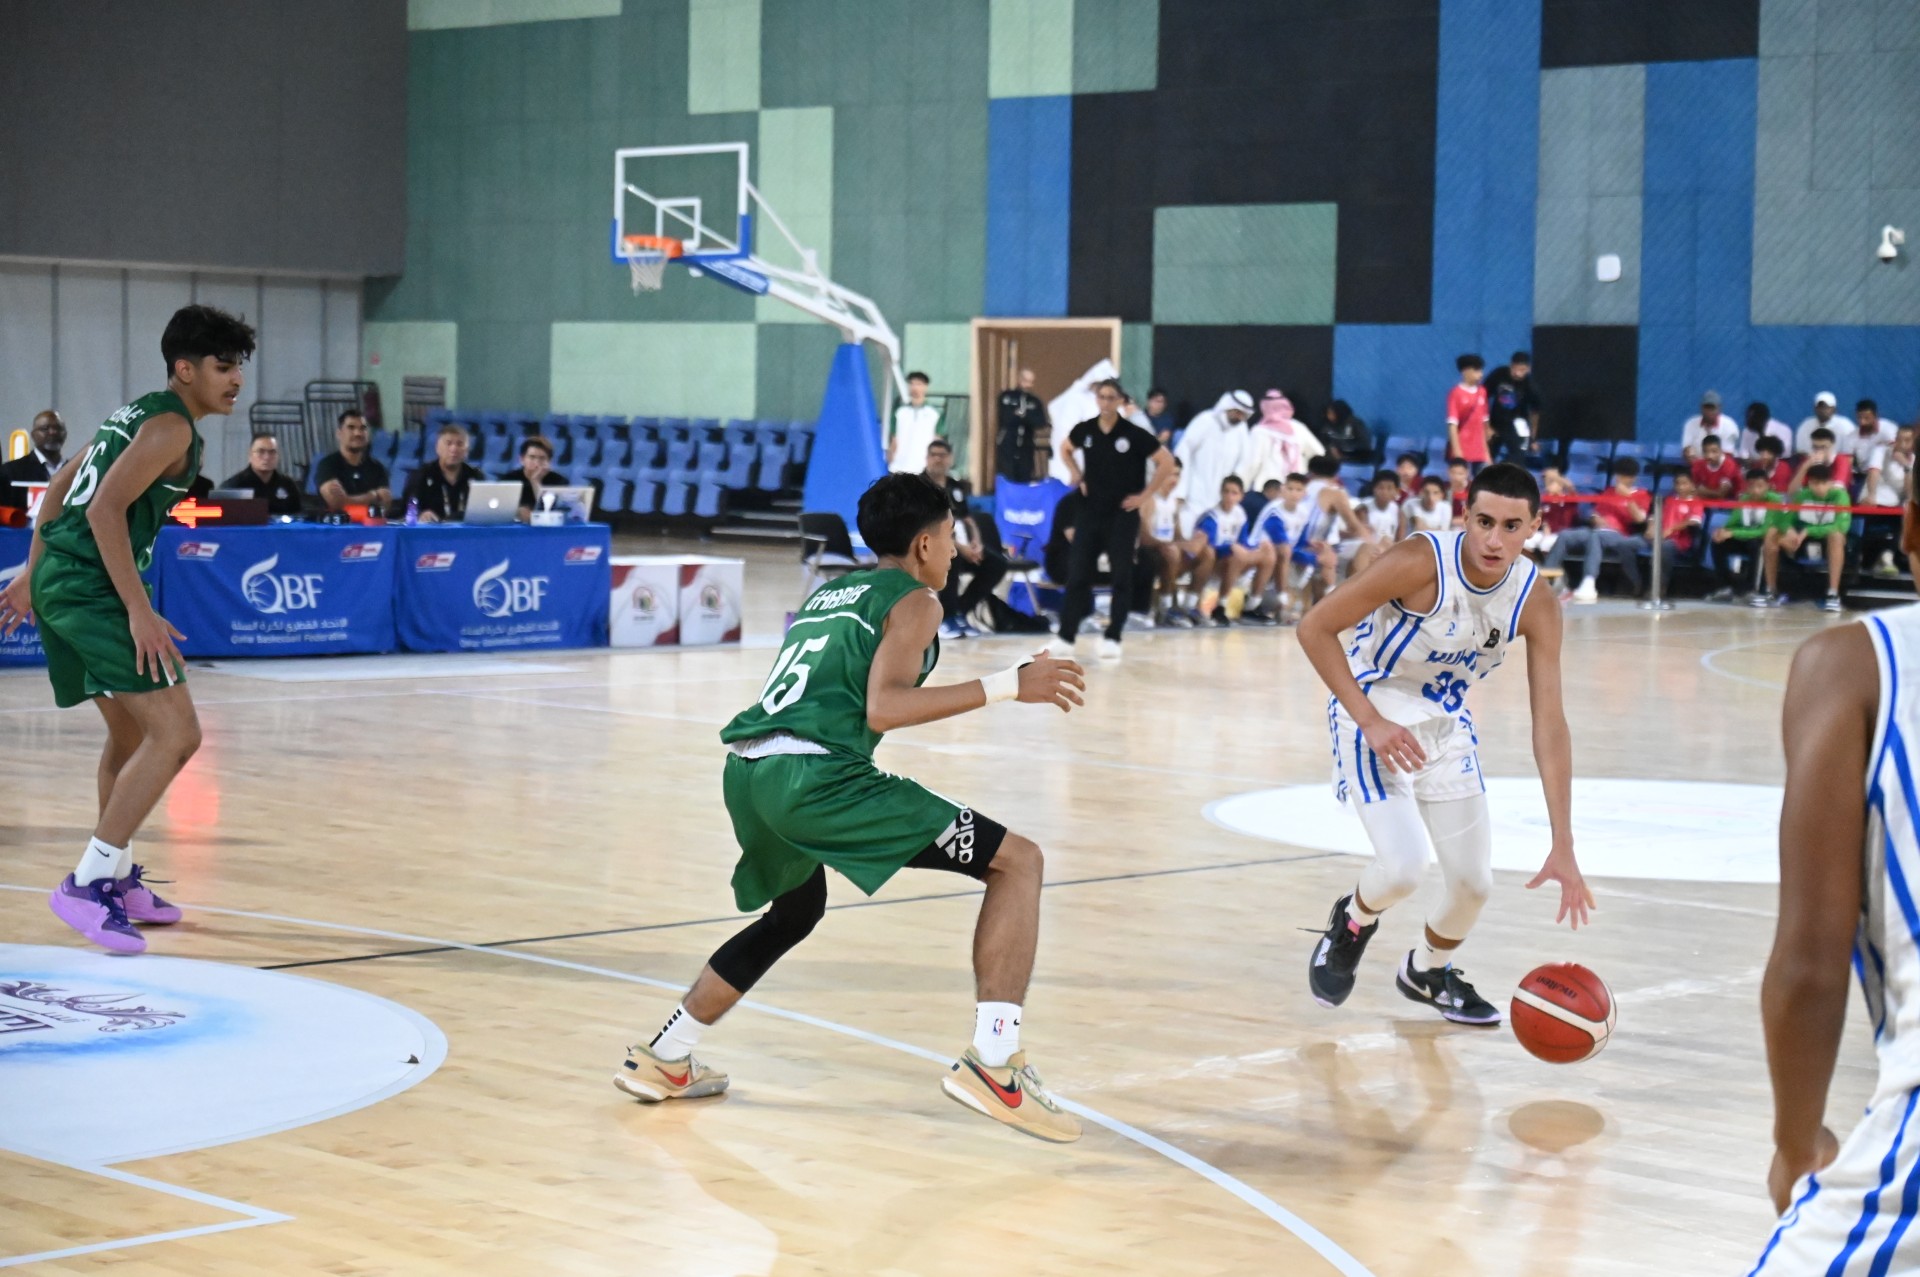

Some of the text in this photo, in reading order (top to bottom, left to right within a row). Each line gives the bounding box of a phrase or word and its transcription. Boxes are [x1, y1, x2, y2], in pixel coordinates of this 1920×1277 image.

[241, 552, 324, 614] QBF
[472, 557, 550, 618] QBF
[758, 634, 831, 716] 15
